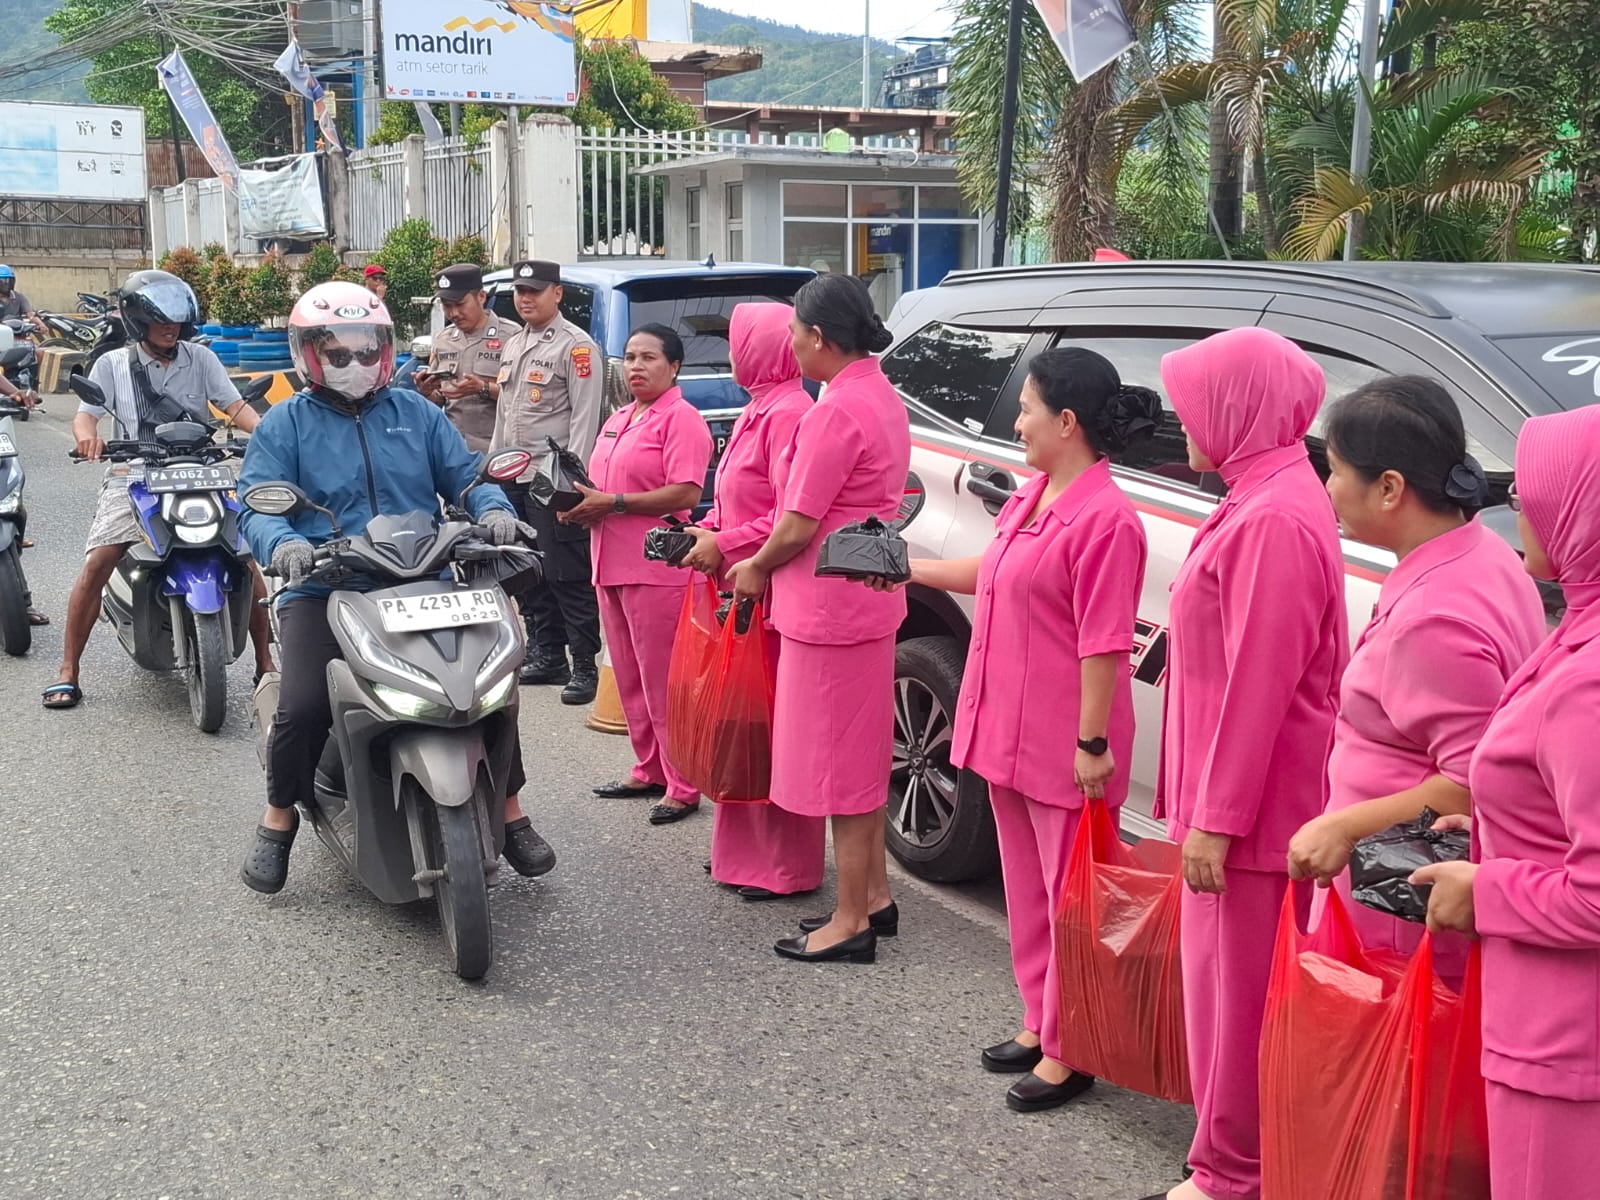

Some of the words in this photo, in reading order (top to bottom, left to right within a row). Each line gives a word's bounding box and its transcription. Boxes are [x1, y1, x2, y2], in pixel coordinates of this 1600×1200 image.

[395, 30, 492, 56] mandiri
[396, 60, 423, 73] atm
[426, 62, 458, 74] setor
[461, 61, 488, 75] tarik
[531, 359, 553, 369] POLRI
[151, 472, 168, 481] PA
[171, 469, 205, 479] 4062
[211, 469, 220, 478] D
[382, 599, 407, 613] PA
[420, 594, 462, 611] 4291
